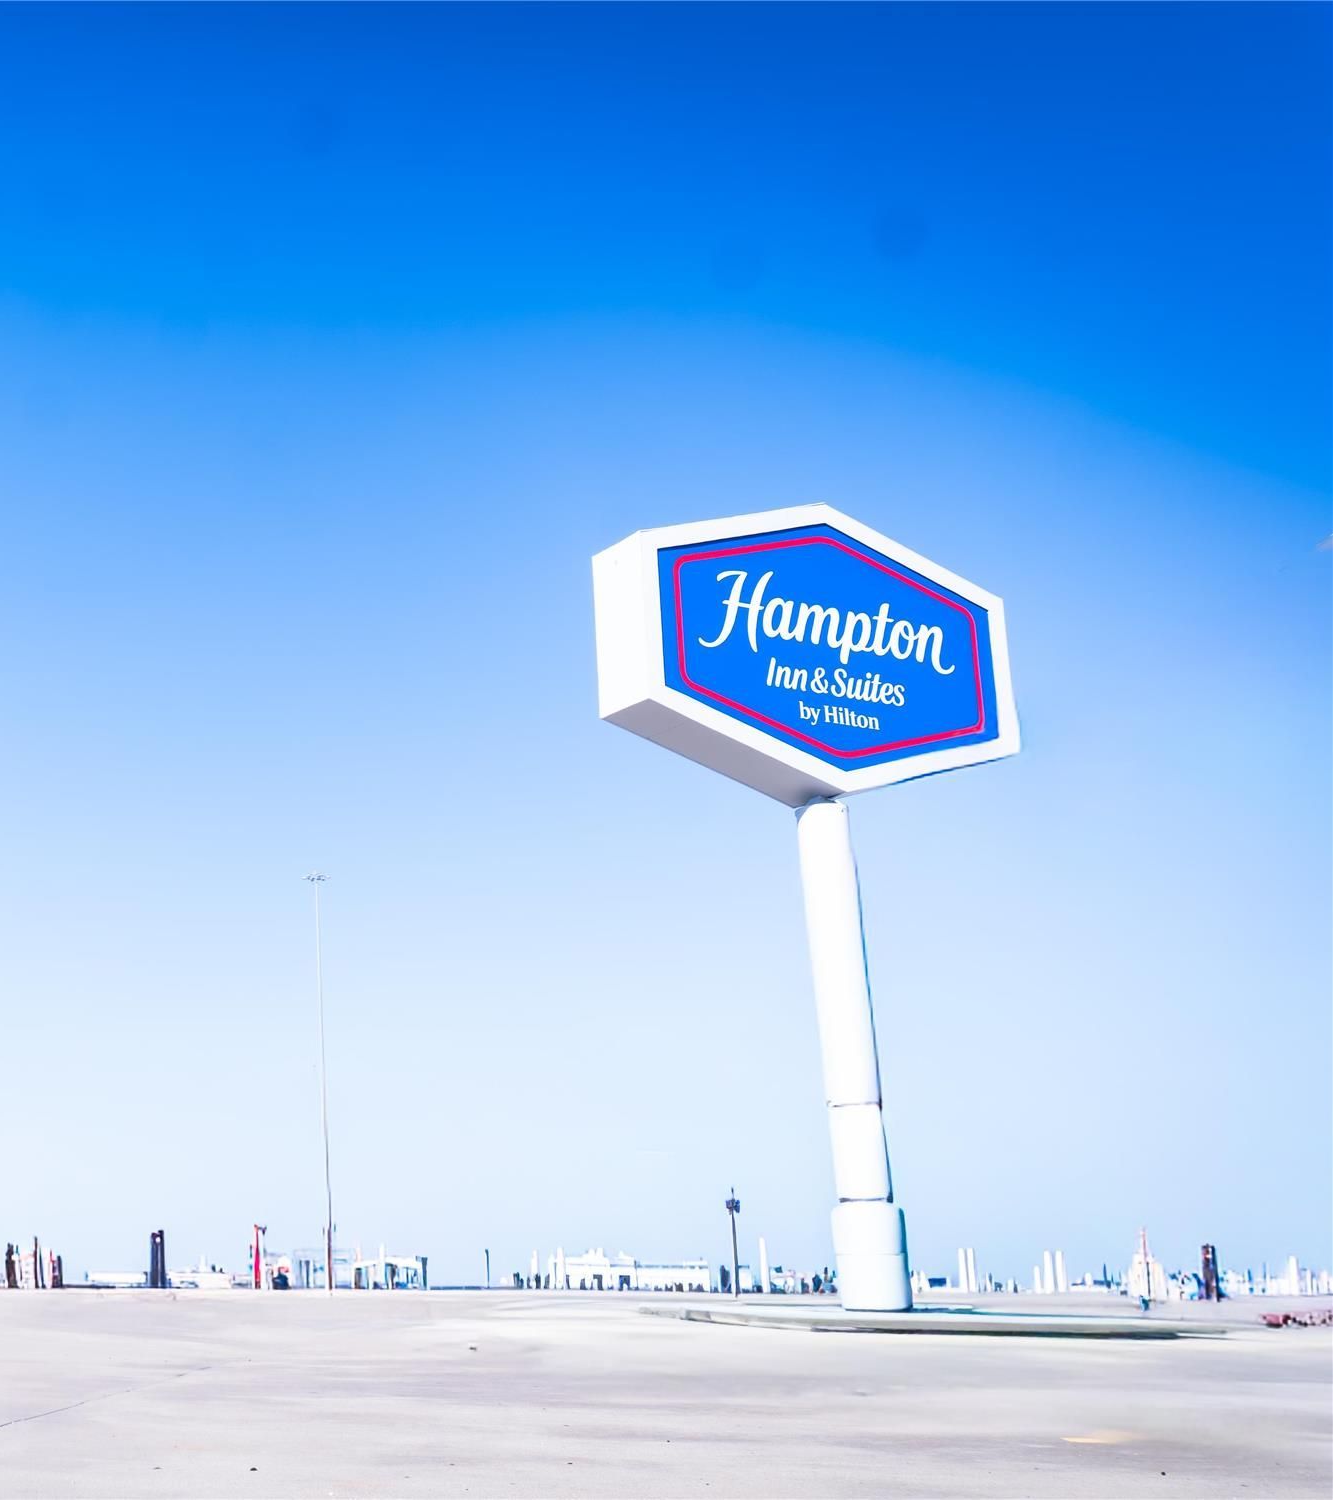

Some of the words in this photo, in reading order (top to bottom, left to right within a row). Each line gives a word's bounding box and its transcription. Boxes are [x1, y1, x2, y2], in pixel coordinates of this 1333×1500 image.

[698, 570, 956, 675] Hampton
[766, 657, 808, 692] Inn
[830, 668, 906, 707] Suites
[799, 700, 821, 726] by
[823, 705, 880, 731] Hilton
